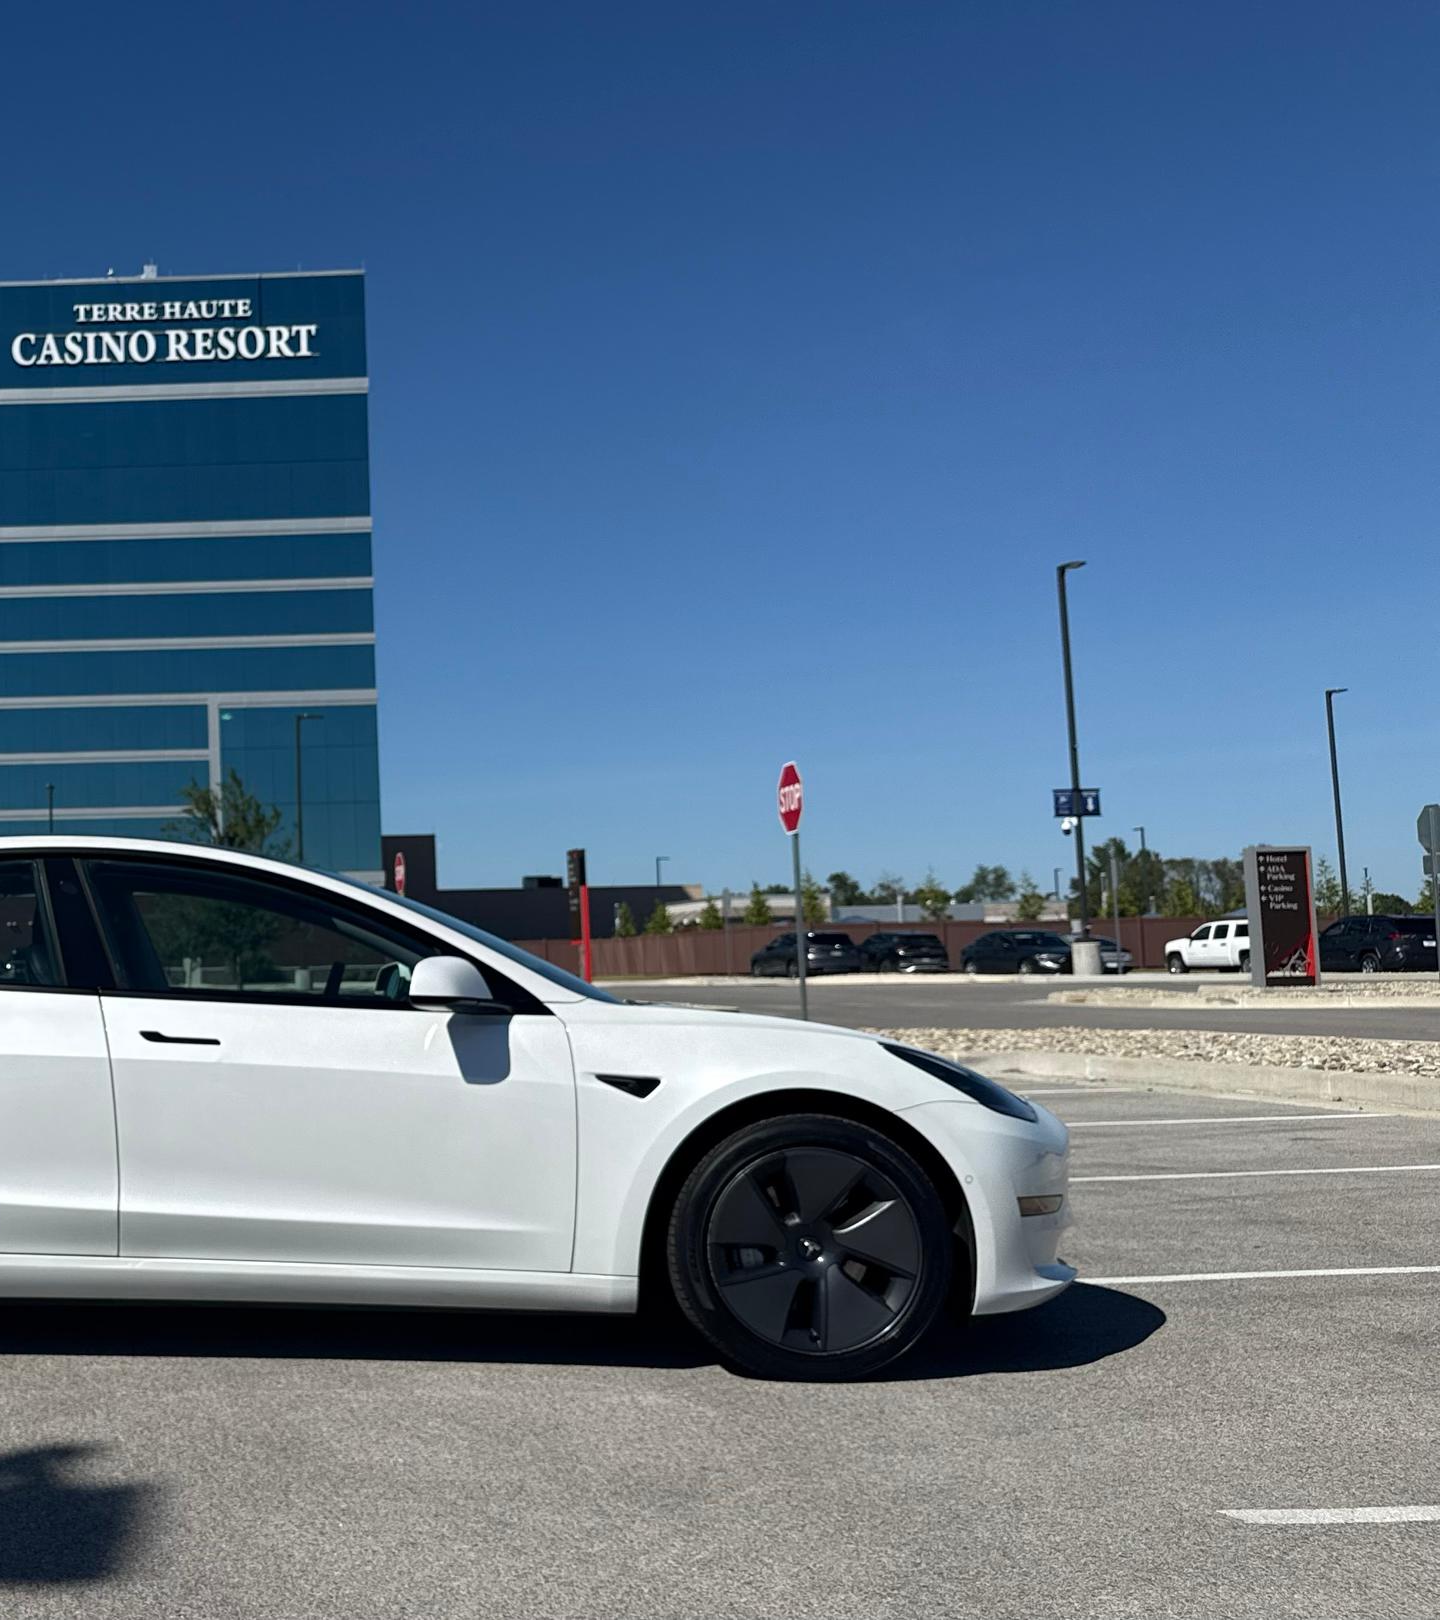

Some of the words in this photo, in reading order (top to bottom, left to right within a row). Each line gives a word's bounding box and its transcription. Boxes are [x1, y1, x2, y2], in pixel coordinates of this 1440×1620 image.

[73, 303, 158, 323] TERRE
[162, 299, 253, 319] HAUTE
[11, 330, 157, 366] CASINO
[165, 325, 318, 362] RESORT
[780, 783, 801, 813] STOP
[1266, 855, 1287, 863] Hotel
[1267, 865, 1285, 873] ADA
[1267, 873, 1295, 881] Parking
[1269, 894, 1284, 902] VIP
[1270, 902, 1298, 910] Parking
